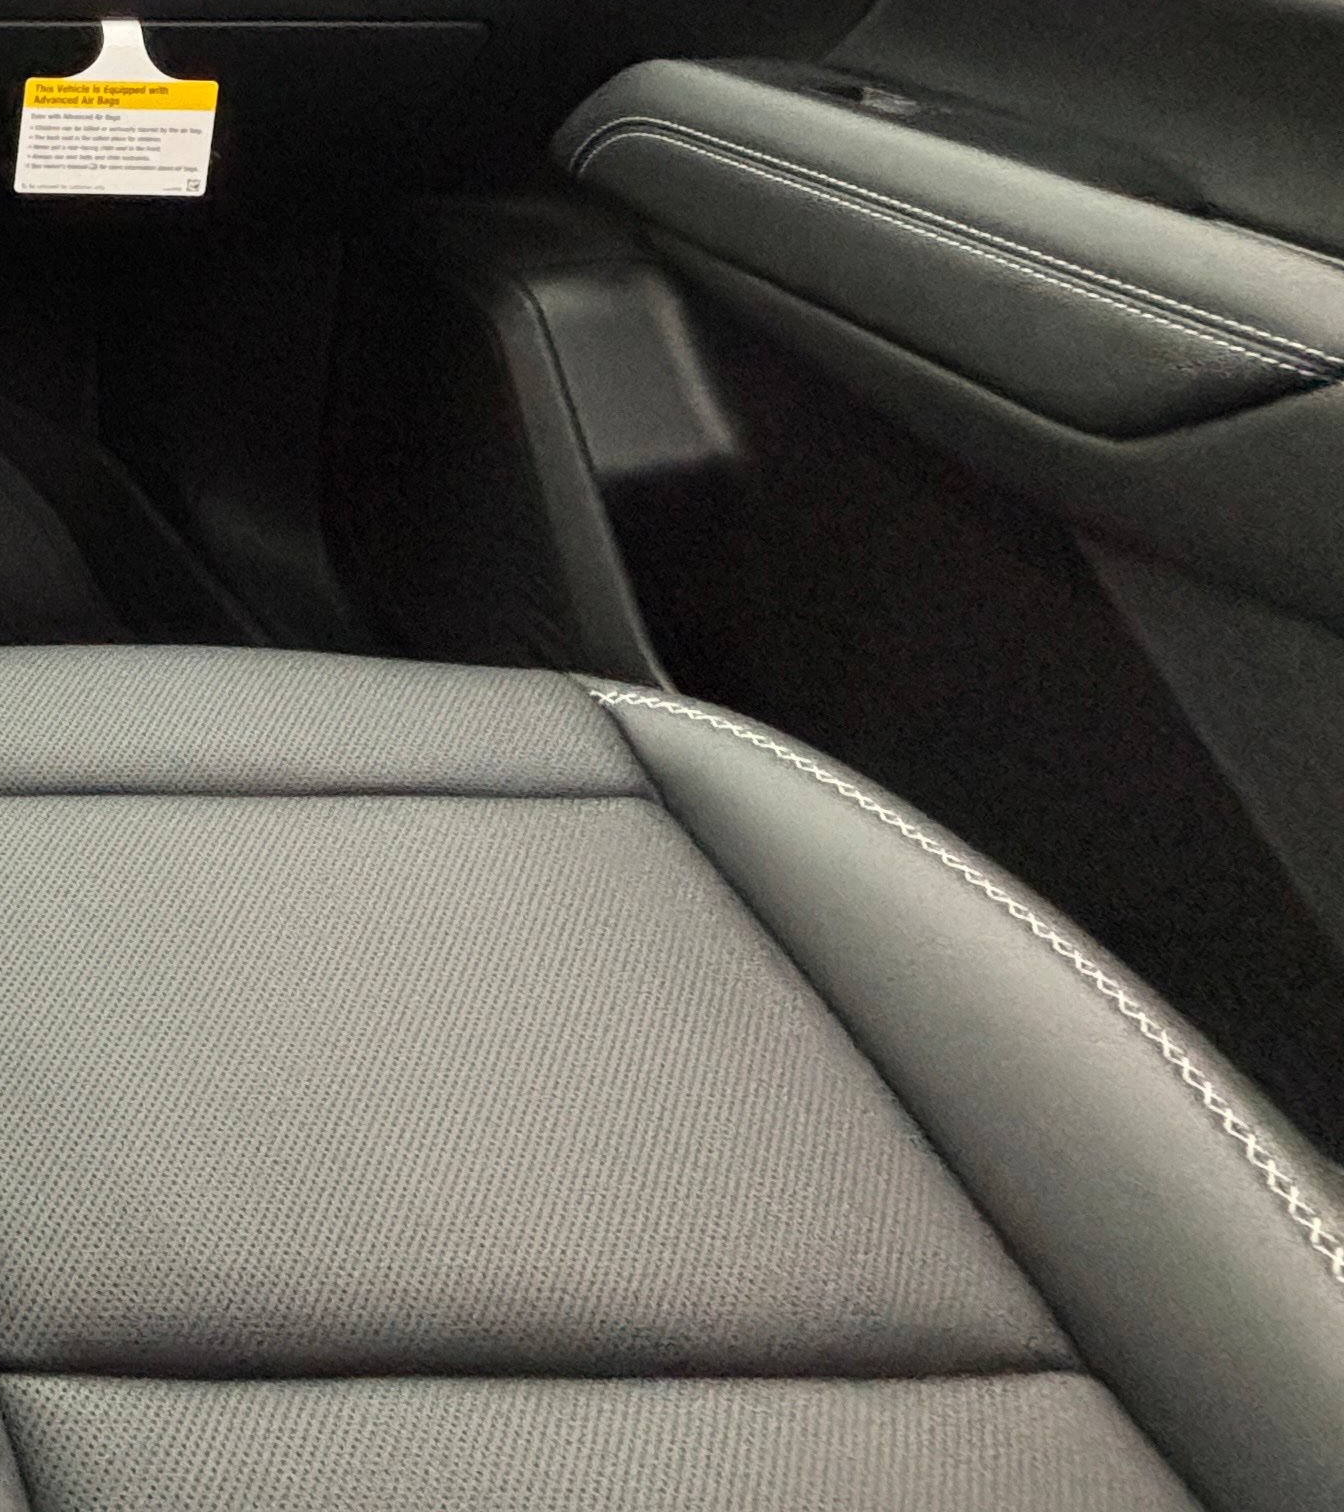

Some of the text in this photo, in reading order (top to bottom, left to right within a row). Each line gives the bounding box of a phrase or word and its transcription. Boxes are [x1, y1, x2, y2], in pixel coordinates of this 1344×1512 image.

[35, 84, 54, 94] This
[57, 84, 90, 94] Vehicle
[103, 85, 146, 96] Equipped
[148, 86, 169, 96] with
[34, 94, 120, 107] Advanced Air Bags
